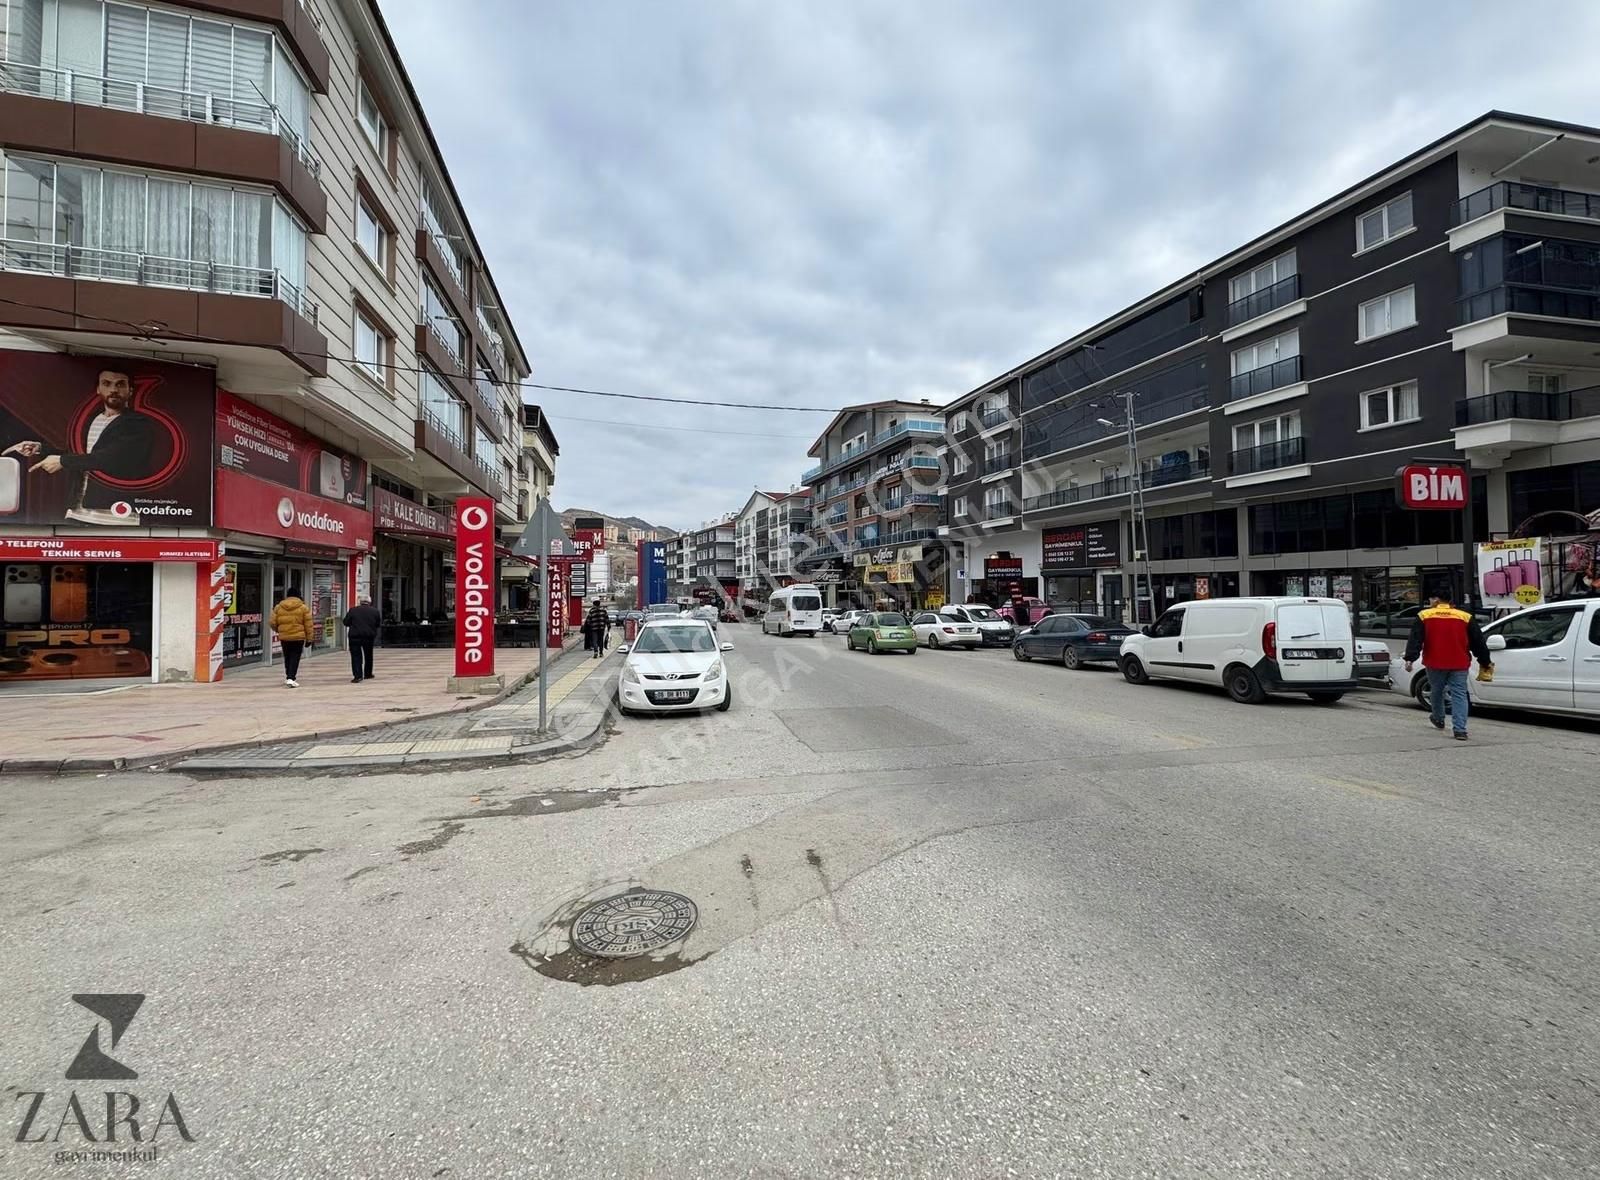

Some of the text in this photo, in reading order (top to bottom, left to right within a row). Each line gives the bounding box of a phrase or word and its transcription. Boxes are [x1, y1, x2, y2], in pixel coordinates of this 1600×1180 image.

[226, 415, 254, 436] YÜKSEK
[254, 427, 267, 441] HIZI
[234, 434, 290, 463] ÇOK UYGUNA DENE
[1411, 467, 1464, 501] BİM
[135, 506, 193, 516] vodafone
[297, 511, 344, 534] vodafone
[394, 500, 413, 522] KALE
[415, 509, 436, 529] DÖNER
[6, 540, 64, 548] TELEFONU
[84, 549, 122, 558] SERVİS
[654, 547, 665, 558] M
[465, 542, 489, 663] vodafone
[551, 564, 562, 636] LAHMACUN
[6, 629, 130, 647] PRO
